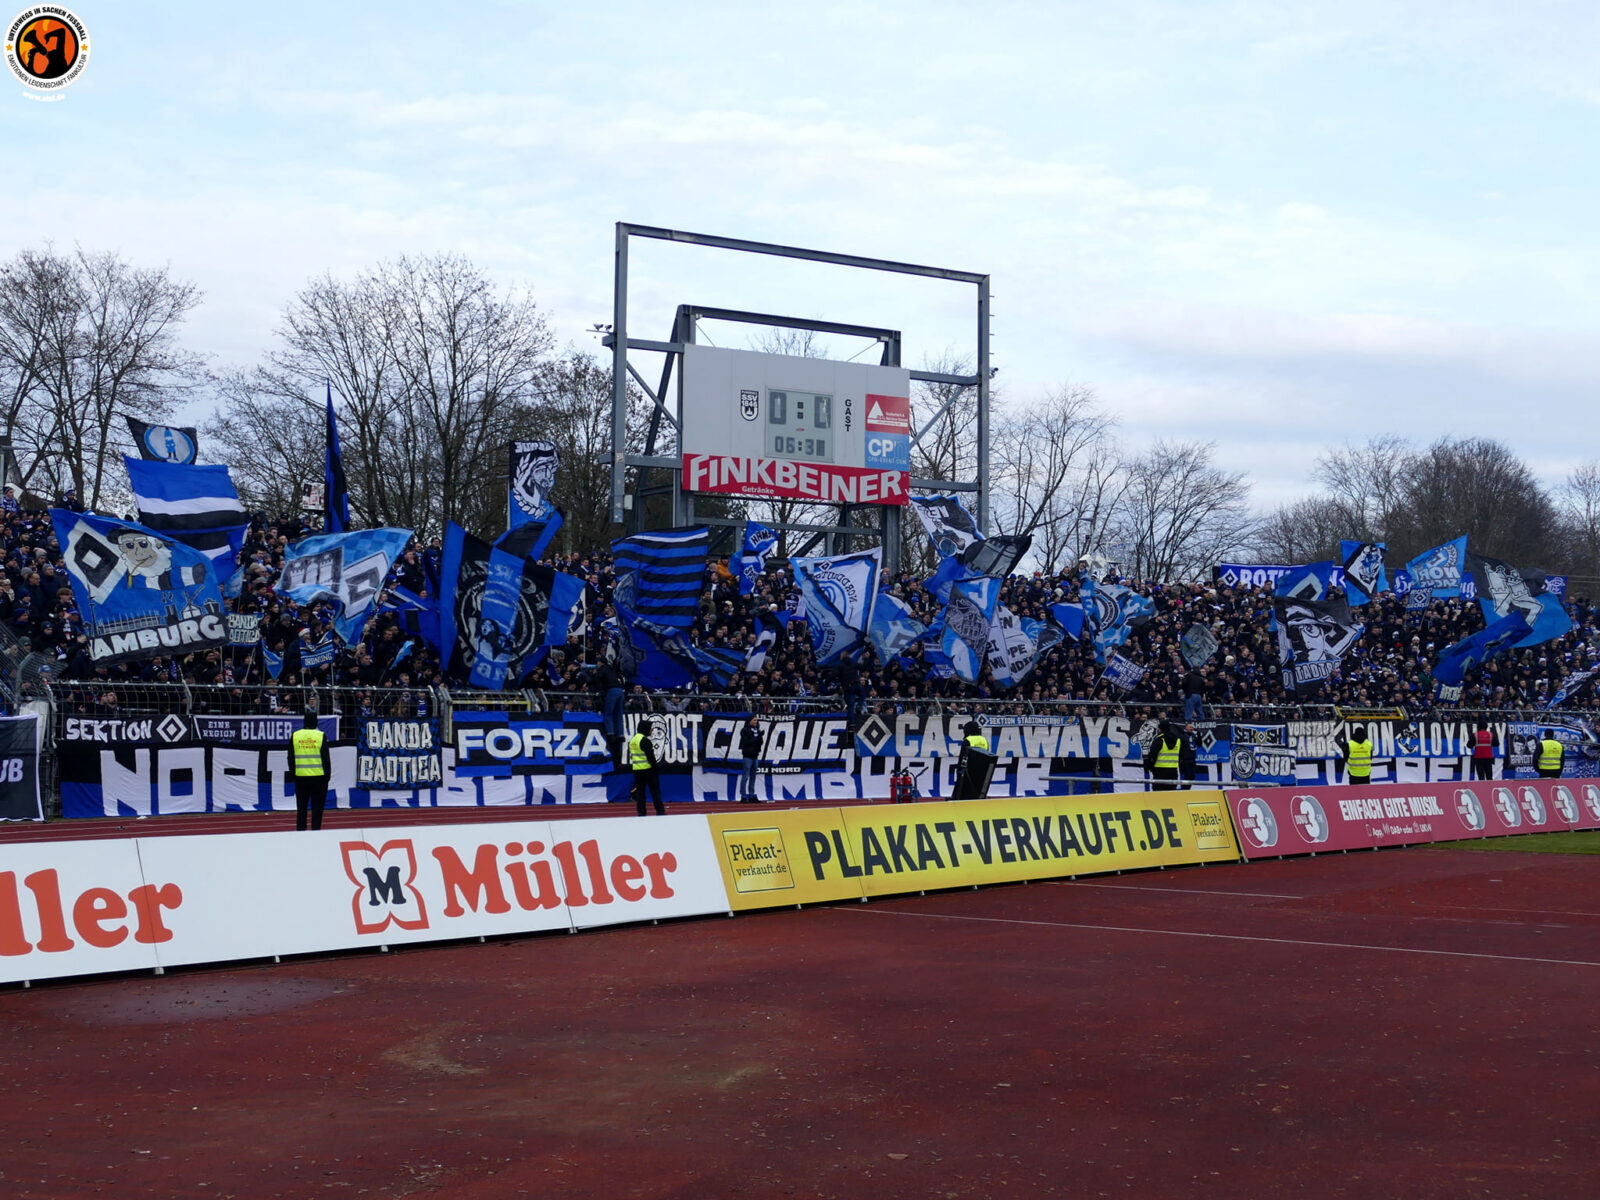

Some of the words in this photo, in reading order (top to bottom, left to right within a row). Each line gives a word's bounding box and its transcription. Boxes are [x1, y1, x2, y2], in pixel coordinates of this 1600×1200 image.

[844, 399, 852, 432] GAST
[689, 455, 902, 503] FINKBEINER
[742, 485, 775, 495] Getränke
[207, 721, 231, 730] EINE
[240, 721, 293, 741] BLAUER
[756, 713, 796, 721] ULTRAS
[202, 729, 236, 739] REGION
[367, 721, 433, 750] BANDA
[457, 727, 610, 760] FORZA
[1418, 721, 1507, 757] LOYAY
[359, 754, 442, 784] CAOTICA
[1191, 812, 1222, 827] Plakat-
[1300, 800, 1320, 838] 3
[1338, 798, 1385, 821] EINFACH
[1382, 797, 1411, 818] GUTE
[1407, 796, 1444, 817] MUSIK.
[1460, 793, 1478, 826] 3
[1498, 791, 1516, 823] 3
[1524, 790, 1541, 821] 3
[1247, 803, 1269, 842] 3
[729, 843, 782, 862] Plakat-
[804, 808, 1183, 882] PLAKAT-VERKAUFT.DE
[432, 838, 678, 918] Müller
[736, 862, 787, 877] verkauft.de
[363, 865, 407, 907] M
